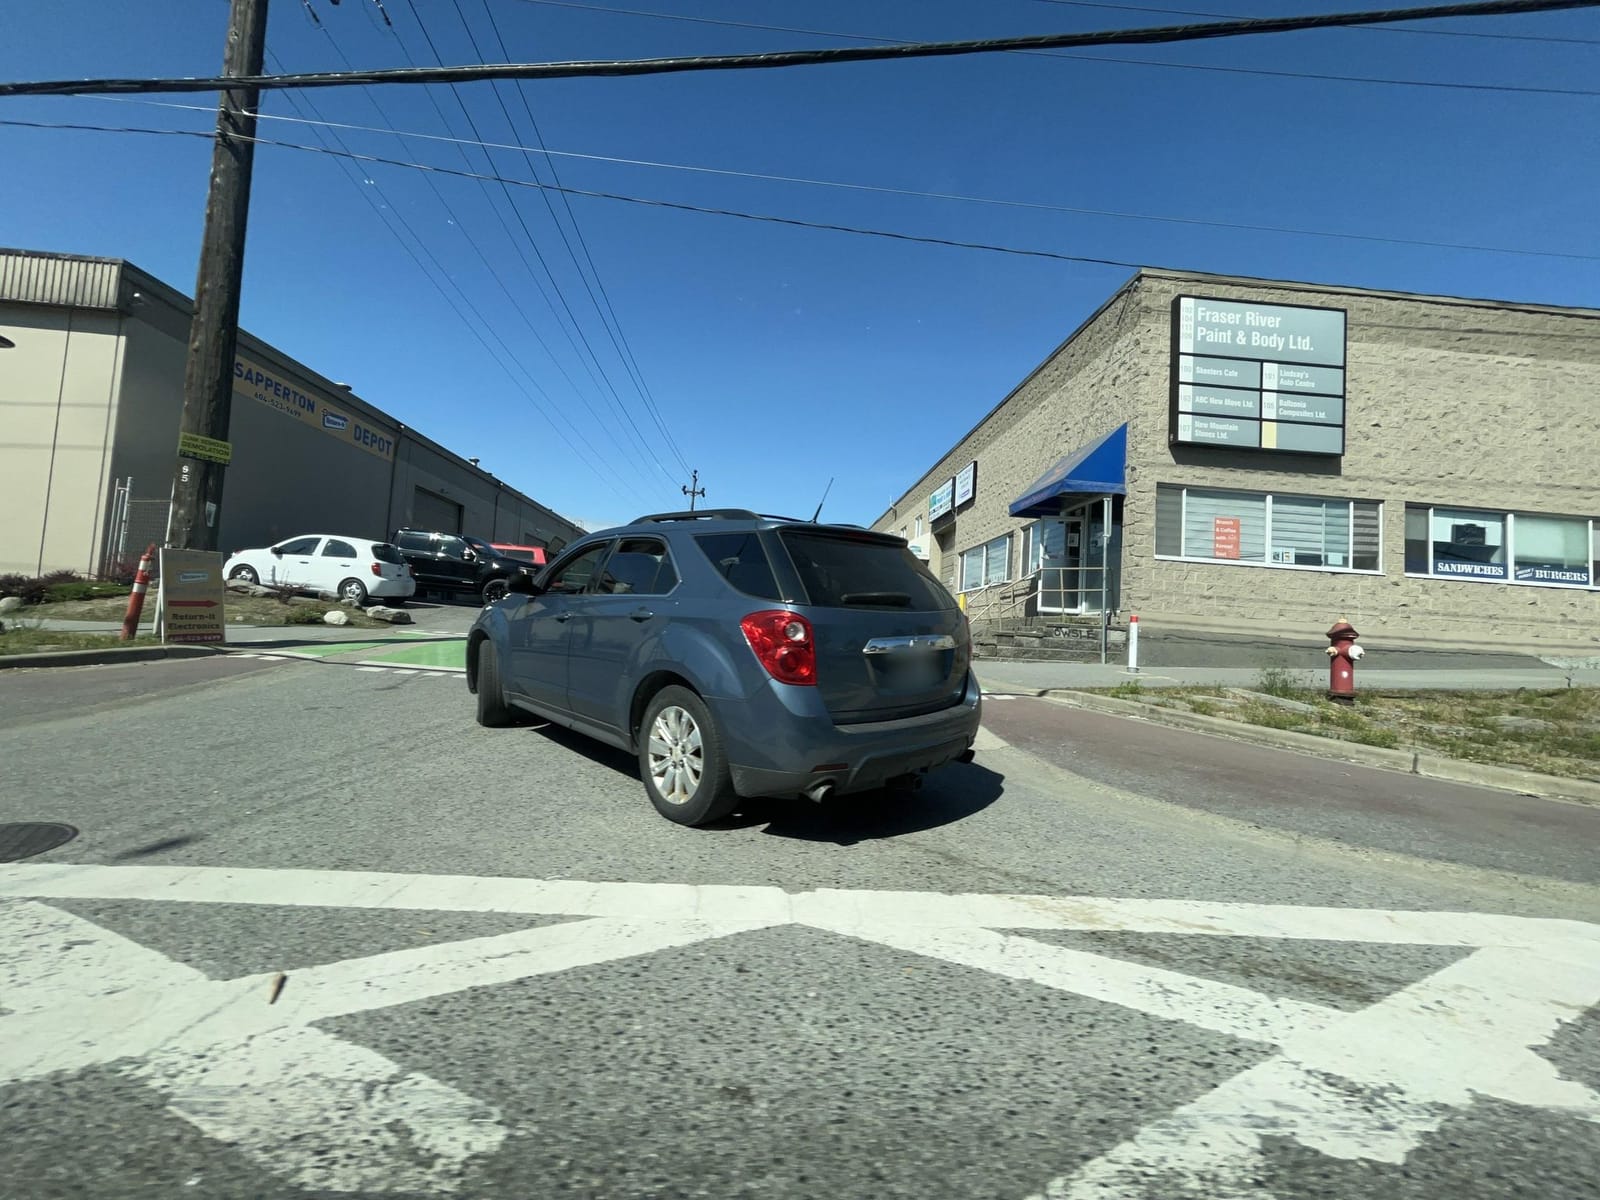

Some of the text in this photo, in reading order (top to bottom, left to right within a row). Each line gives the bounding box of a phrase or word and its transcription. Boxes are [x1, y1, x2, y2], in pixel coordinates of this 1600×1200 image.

[1197, 307, 1281, 328] Fraser River
[1197, 326, 1232, 344] Paint
[1236, 330, 1246, 345] &
[1251, 331, 1285, 351] Body
[1289, 334, 1314, 351] Ltd.
[234, 362, 315, 413] SAPPERTON
[353, 424, 393, 455] DEPOT
[1437, 562, 1504, 576] SANDWICHES
[1535, 569, 1588, 582] BURGERS
